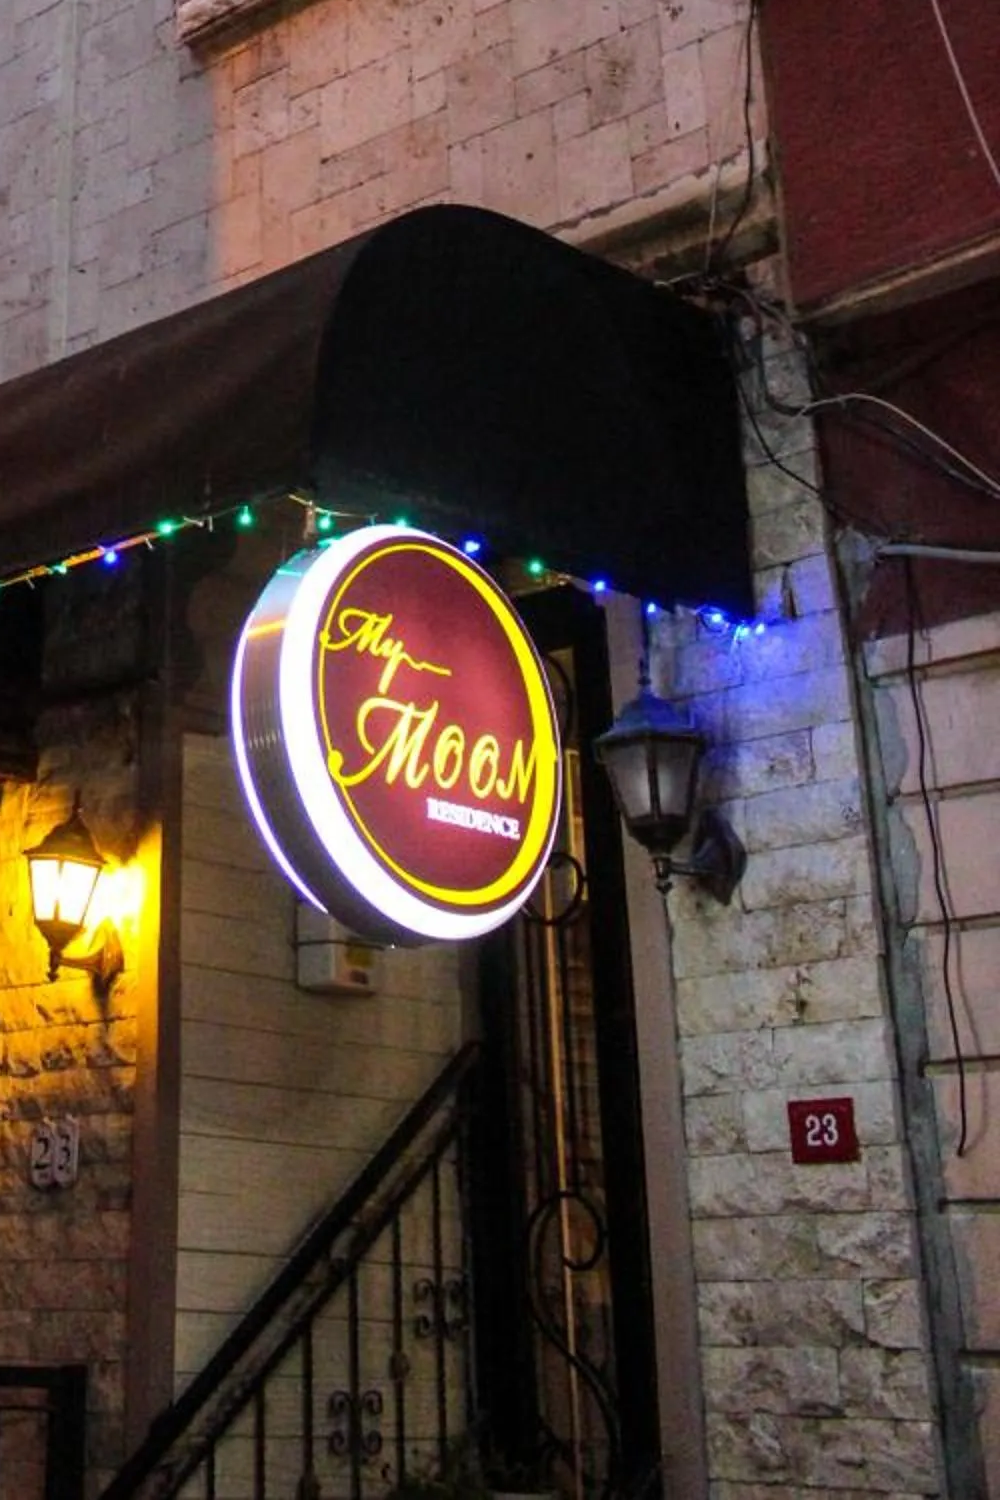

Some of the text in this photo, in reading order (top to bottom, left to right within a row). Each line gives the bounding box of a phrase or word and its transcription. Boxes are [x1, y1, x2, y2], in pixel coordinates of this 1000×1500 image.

[325, 608, 451, 694] My
[805, 1113, 839, 1146] 23
[34, 1132, 71, 1171] 23
